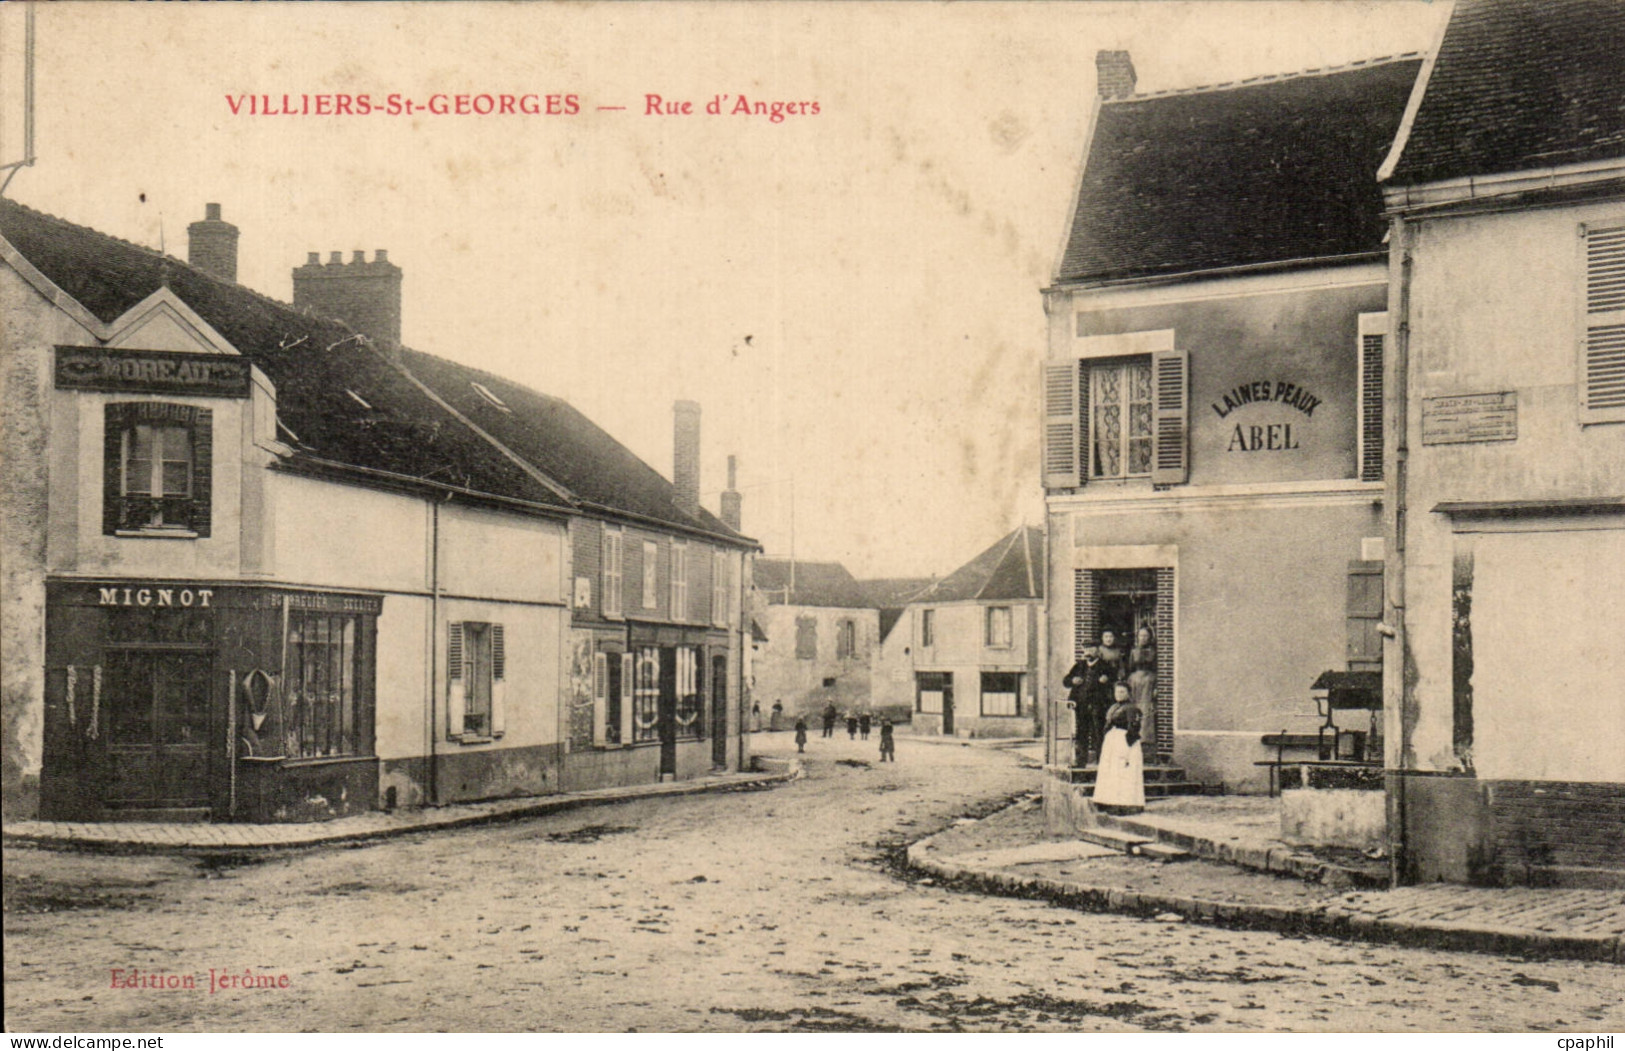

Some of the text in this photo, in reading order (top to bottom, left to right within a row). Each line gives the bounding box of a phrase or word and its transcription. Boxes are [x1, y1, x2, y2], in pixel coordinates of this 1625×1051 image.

[101, 357, 211, 384] MOREAU
[1274, 381, 1322, 417] PEAUX
[1227, 422, 1300, 452] ABEL
[98, 587, 214, 607] MIGNOT
